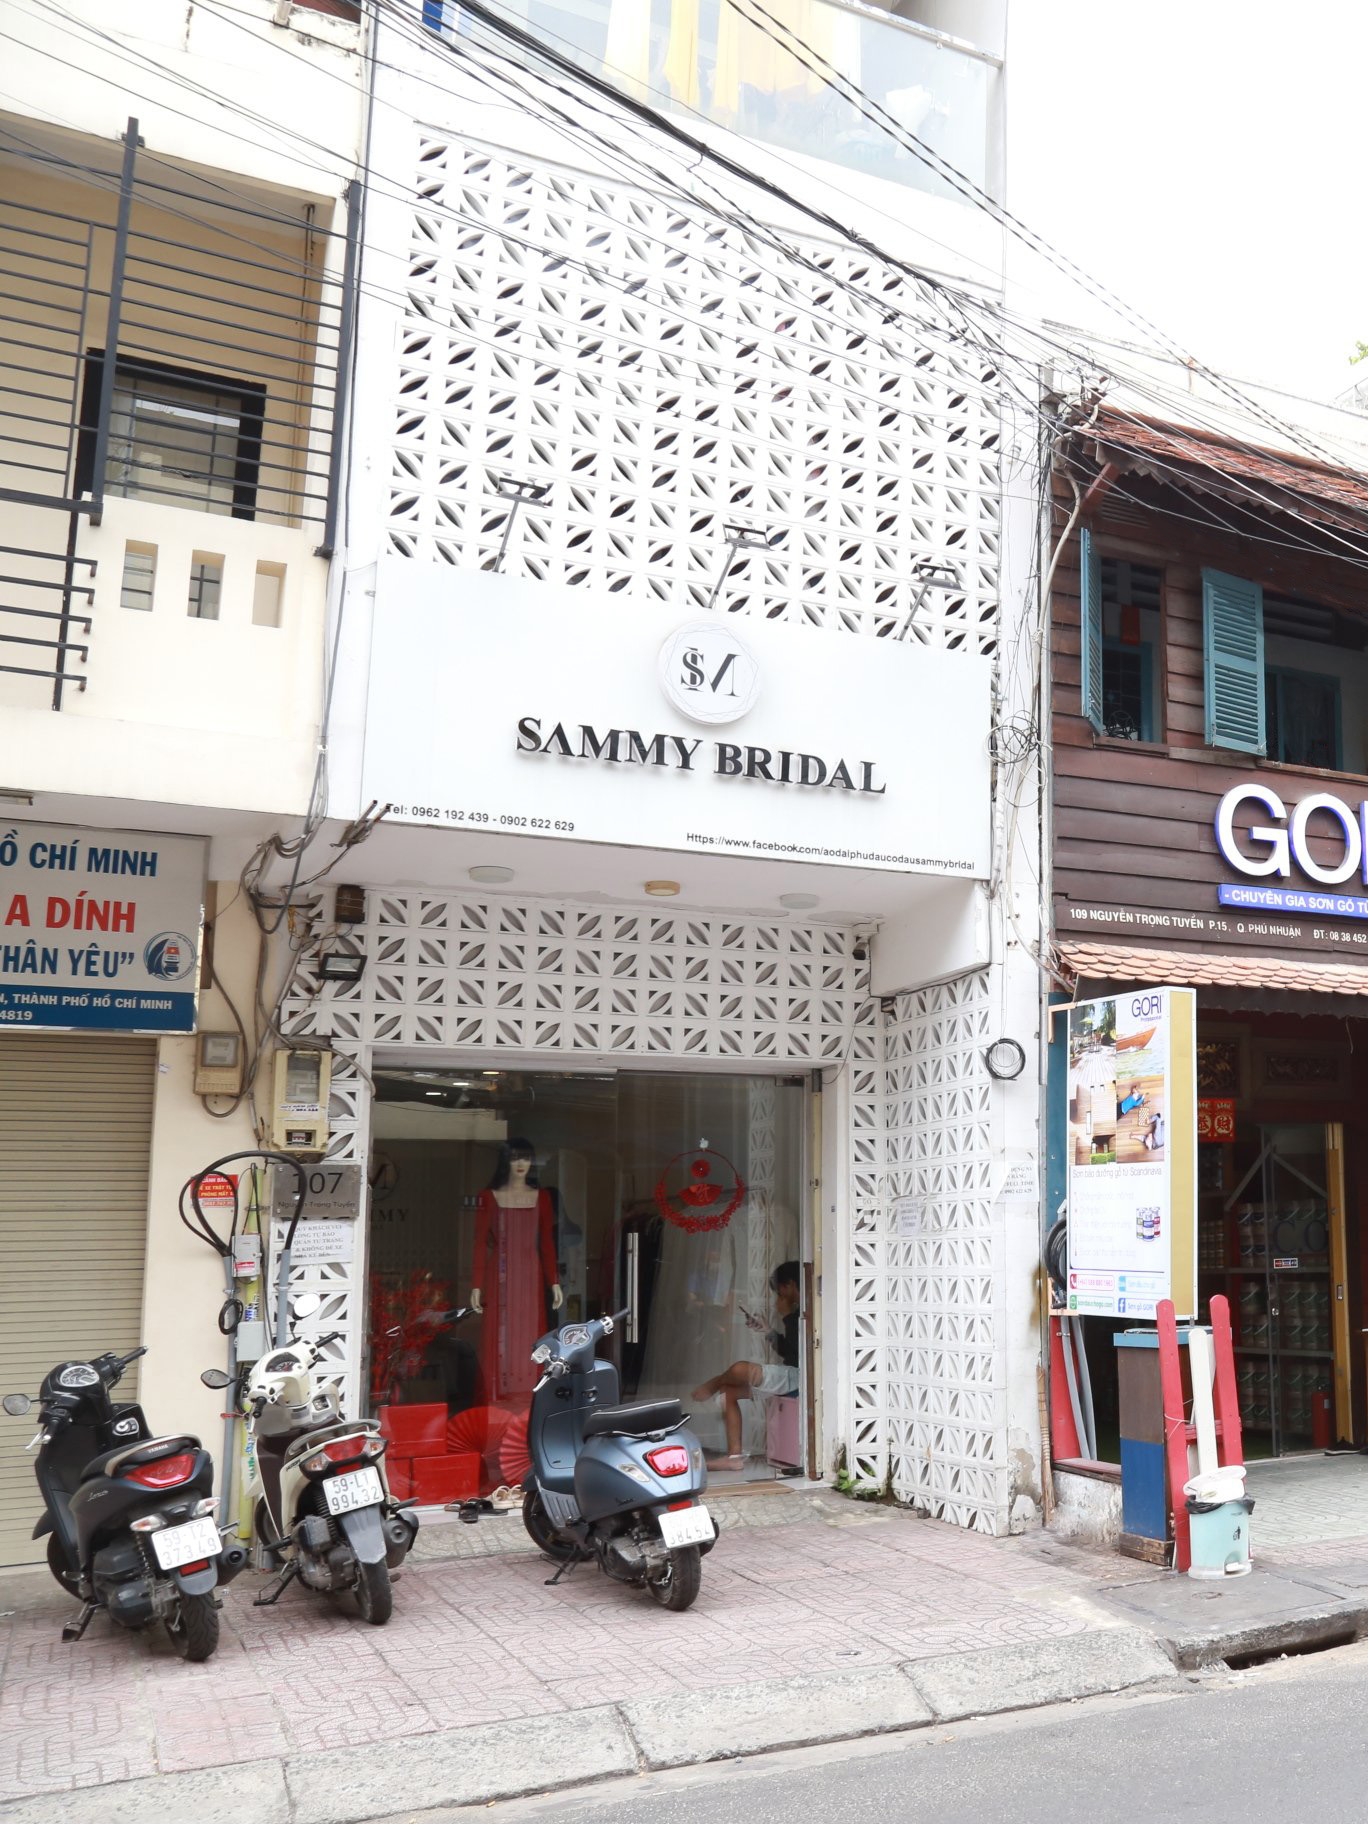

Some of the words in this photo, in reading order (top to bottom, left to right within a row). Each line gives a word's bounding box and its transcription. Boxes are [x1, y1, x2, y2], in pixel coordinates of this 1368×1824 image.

[516, 716, 704, 772] SAMMY
[713, 742, 888, 795] BRIDAL
[412, 806, 440, 818] 0962
[445, 809, 464, 821] 192
[468, 811, 489, 823] 439
[500, 814, 528, 828] 0902
[531, 818, 551, 829] 622
[554, 820, 576, 832] 629
[29, 840, 80, 871] CHÍ
[87, 847, 159, 877] MINH
[5, 894, 31, 927] A
[45, 890, 137, 934] DÍNH
[1231, 889, 1283, 906] CHUYÊN
[1285, 894, 1306, 908] GIA
[1309, 896, 1335, 911] SƠN
[1337, 898, 1355, 912] GỖ
[1070, 908, 1088, 919] 109
[1089, 907, 1135, 923] NGUYỄN
[1135, 913, 1170, 928] TRỌNG
[1172, 912, 1204, 929] TUYỂN
[1248, 922, 1268, 936] PHÚ
[1270, 924, 1301, 938] NHUẬN
[1330, 931, 1340, 942] 08
[1341, 931, 1351, 942] 38
[1352, 932, 1366, 944] 452
[0, 939, 59, 976] HÂN
[12, 993, 58, 1007] THÀNH
[62, 993, 91, 1007] PHỐ
[93, 993, 111, 1008] HỒ
[115, 996, 137, 1009] CHÍ
[140, 998, 173, 1010] MINH
[1131, 995, 1162, 1018] GORI
[292, 1172, 344, 1195] 107
[332, 1486, 380, 1512] 994.32
[162, 1537, 217, 1566] 373.49
